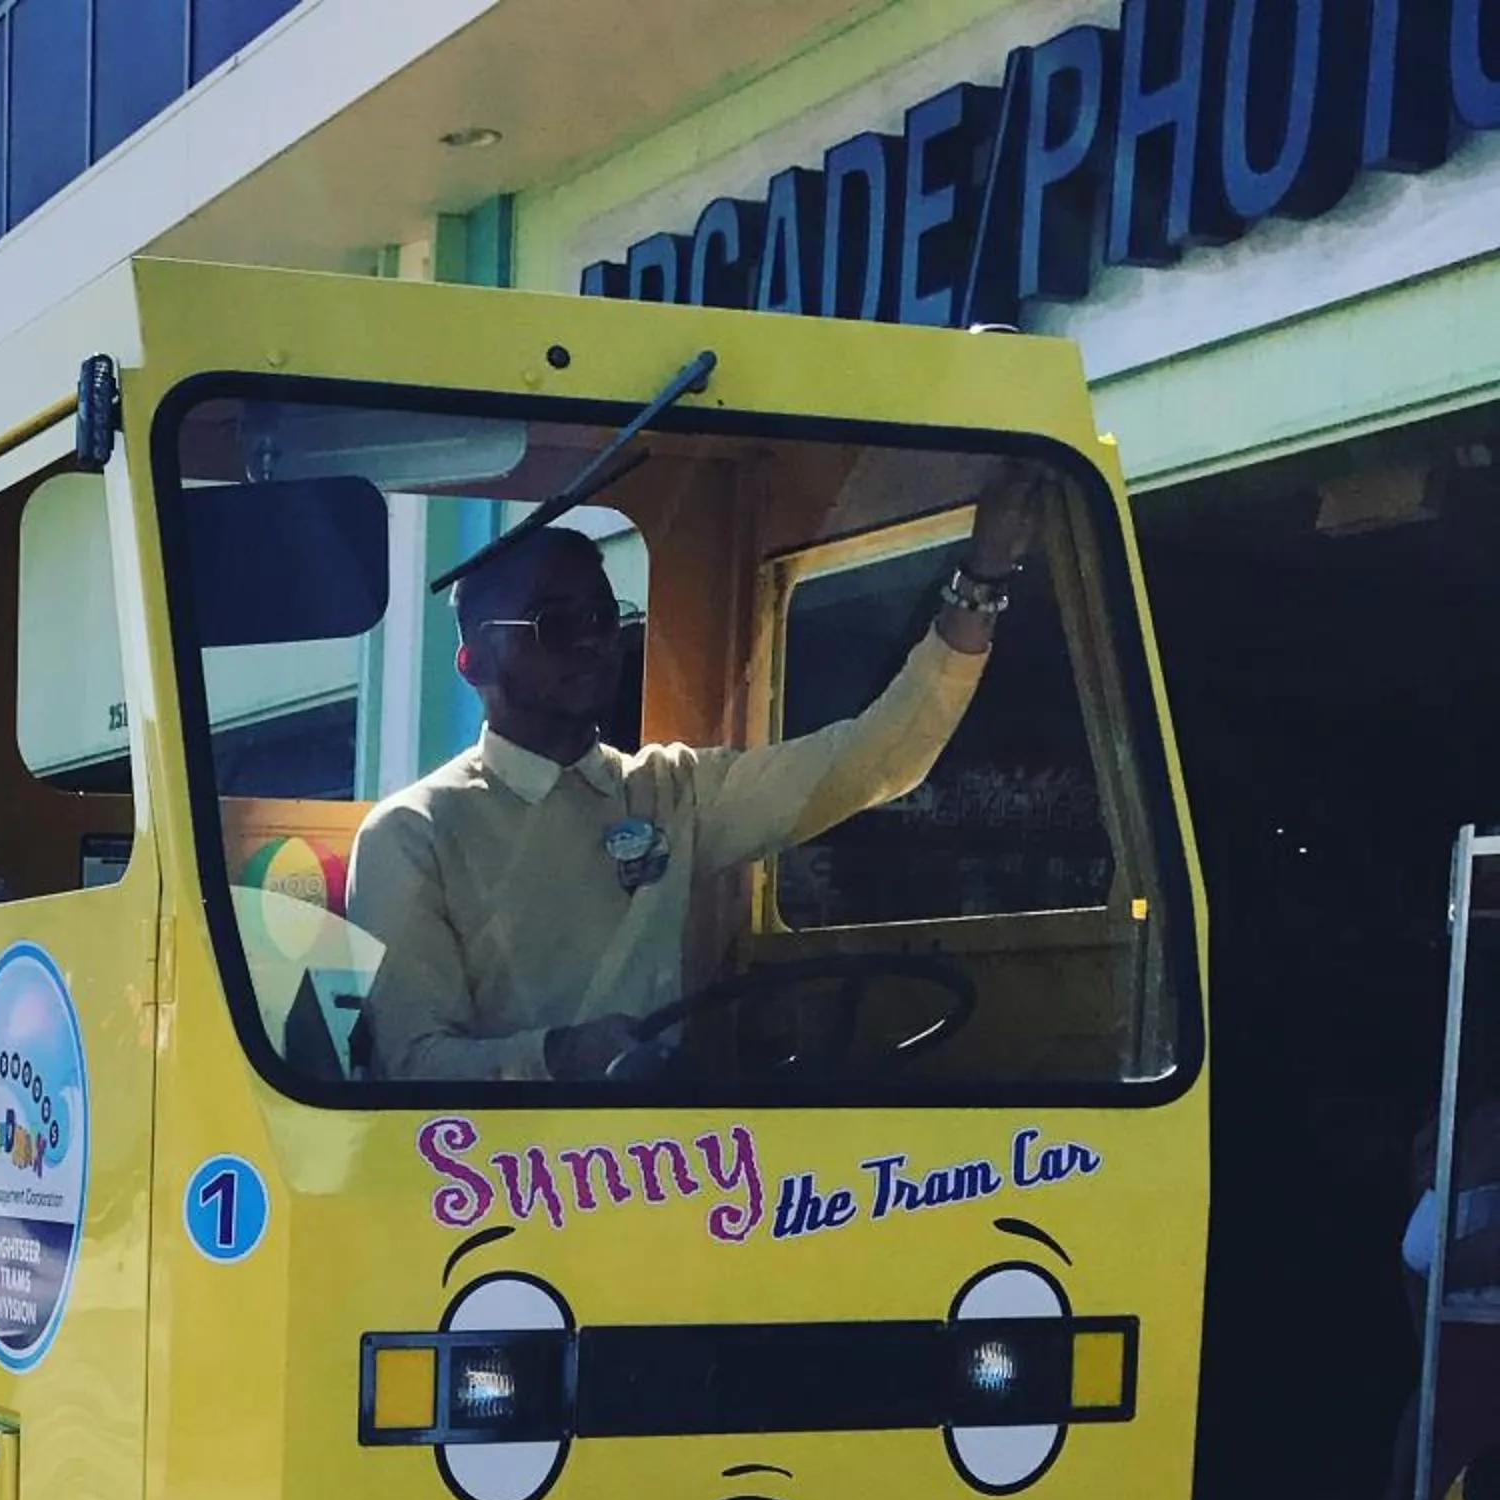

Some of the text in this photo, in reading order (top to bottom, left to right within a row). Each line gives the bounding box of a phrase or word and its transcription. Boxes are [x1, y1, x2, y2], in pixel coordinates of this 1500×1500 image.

[198, 1171, 238, 1246] 1
[417, 1118, 1100, 1242] Sunny the Tram Car
[0, 1266, 31, 1293] TRAMS
